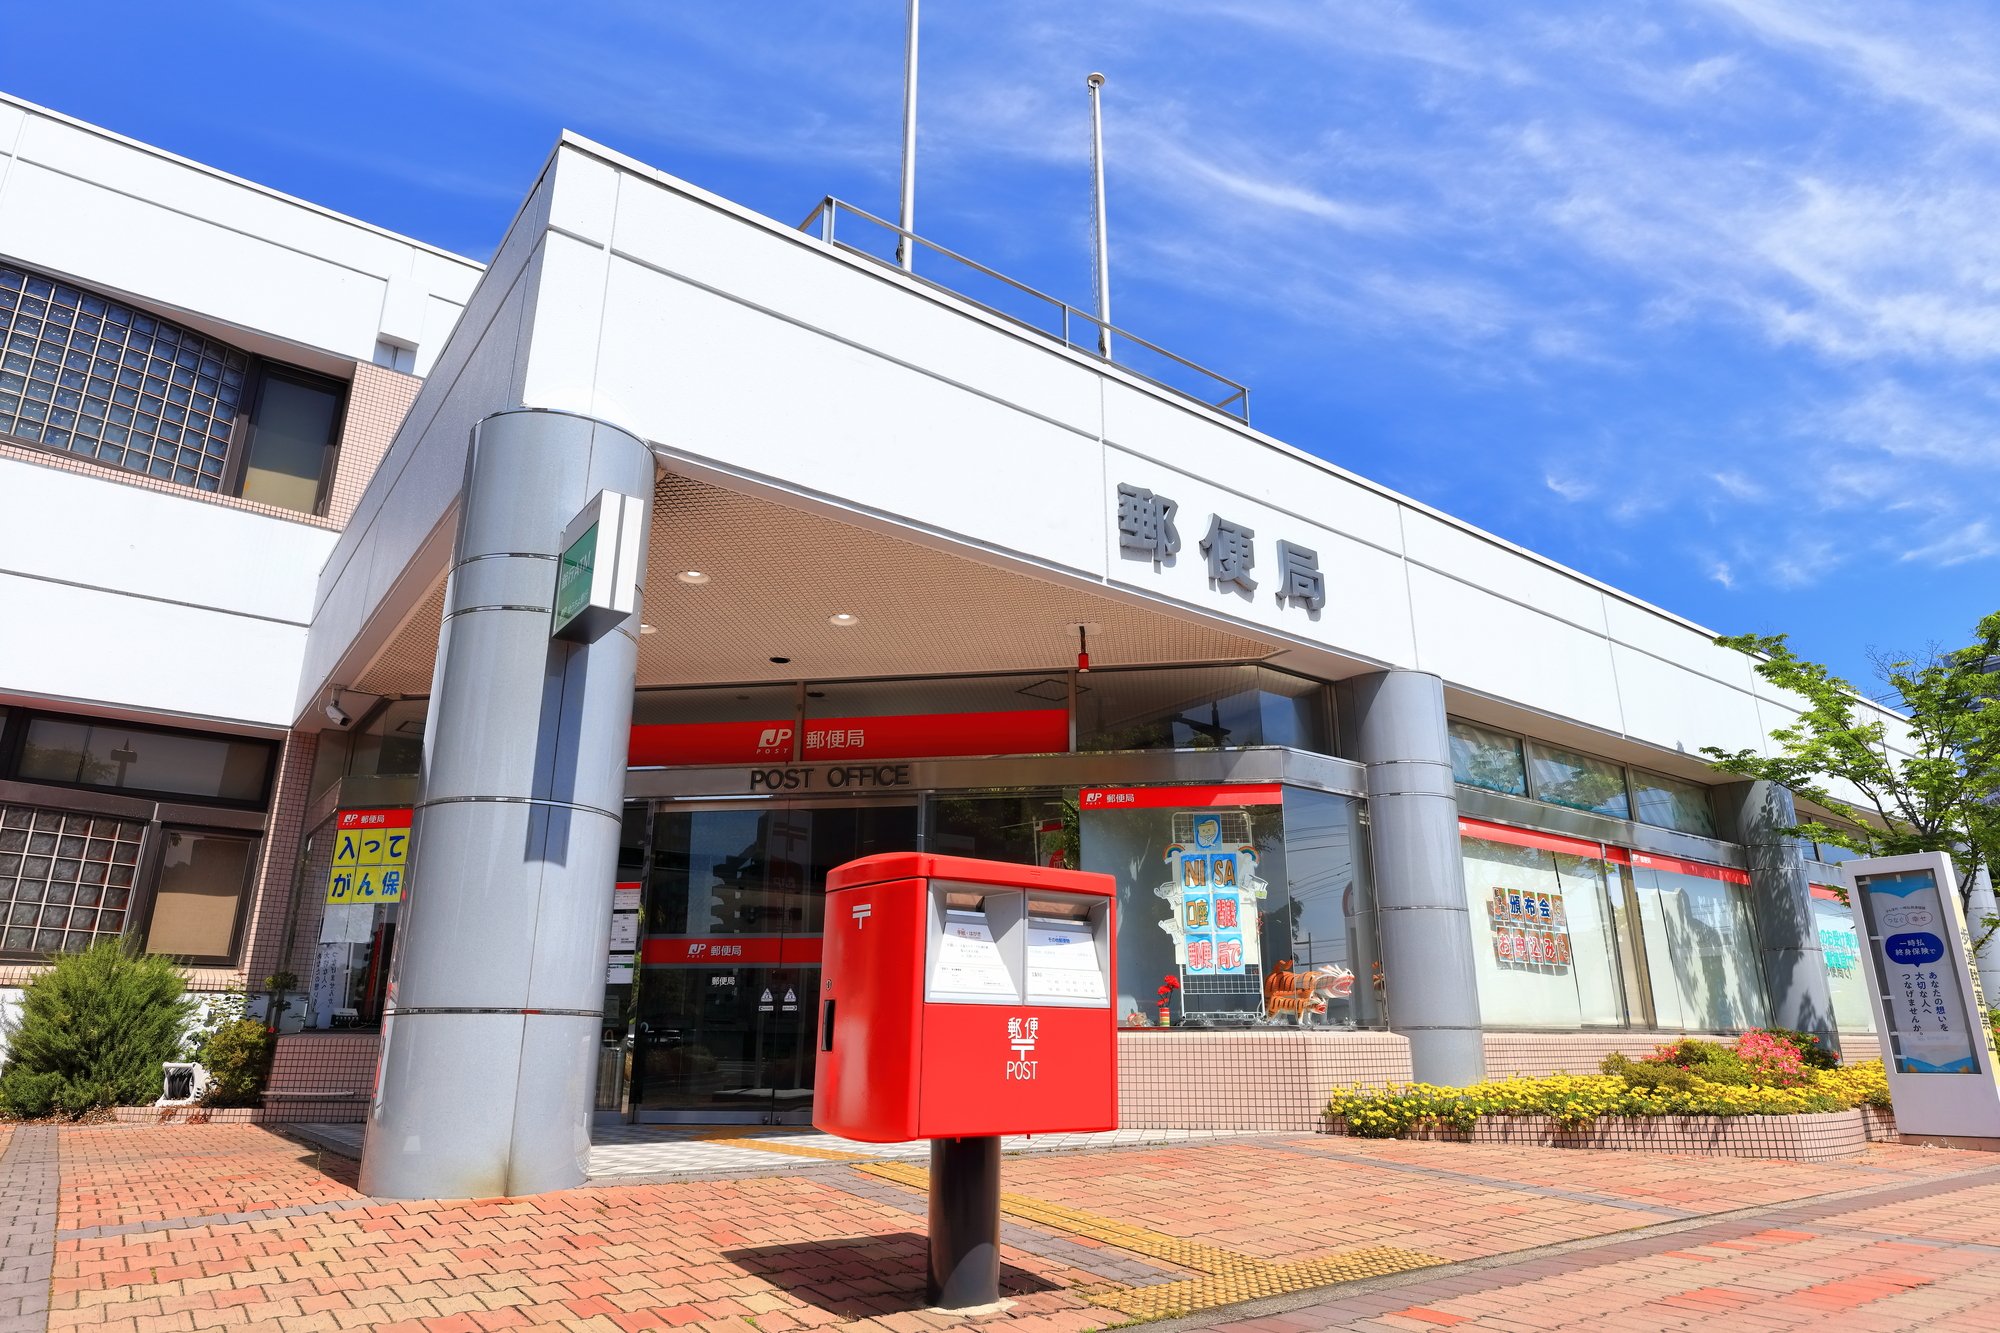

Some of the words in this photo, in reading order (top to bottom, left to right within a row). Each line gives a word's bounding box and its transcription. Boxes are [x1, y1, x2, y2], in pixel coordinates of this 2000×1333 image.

[1117, 482, 1326, 609] 郵便局
[806, 729, 865, 749] 郵便局
[751, 768, 814, 790] POST
[827, 765, 910, 787] OFFICE
[1106, 793, 1134, 803] 郵便局
[361, 815, 384, 824] 郵便局
[338, 835, 405, 860] 入って
[332, 871, 399, 897] がん保
[1186, 898, 1238, 928] 口座開設
[1509, 894, 1551, 918] 頒布会
[710, 945, 742, 957] 郵便局
[1188, 941, 1242, 969] 郵便局で
[1499, 935, 1556, 958] お申込み
[1895, 947, 1936, 956] 終身保険で
[711, 976, 736, 986] 郵便局
[1915, 972, 1932, 1014] 大切な人へ
[1960, 927, 1997, 1053] 歩道駐車禁止
[1902, 973, 1924, 1036] つなげませんか。
[1929, 972, 1949, 1032] あなたの想いを
[1007, 1017, 1039, 1039] 郵便
[1007, 1061, 1038, 1080] POST
